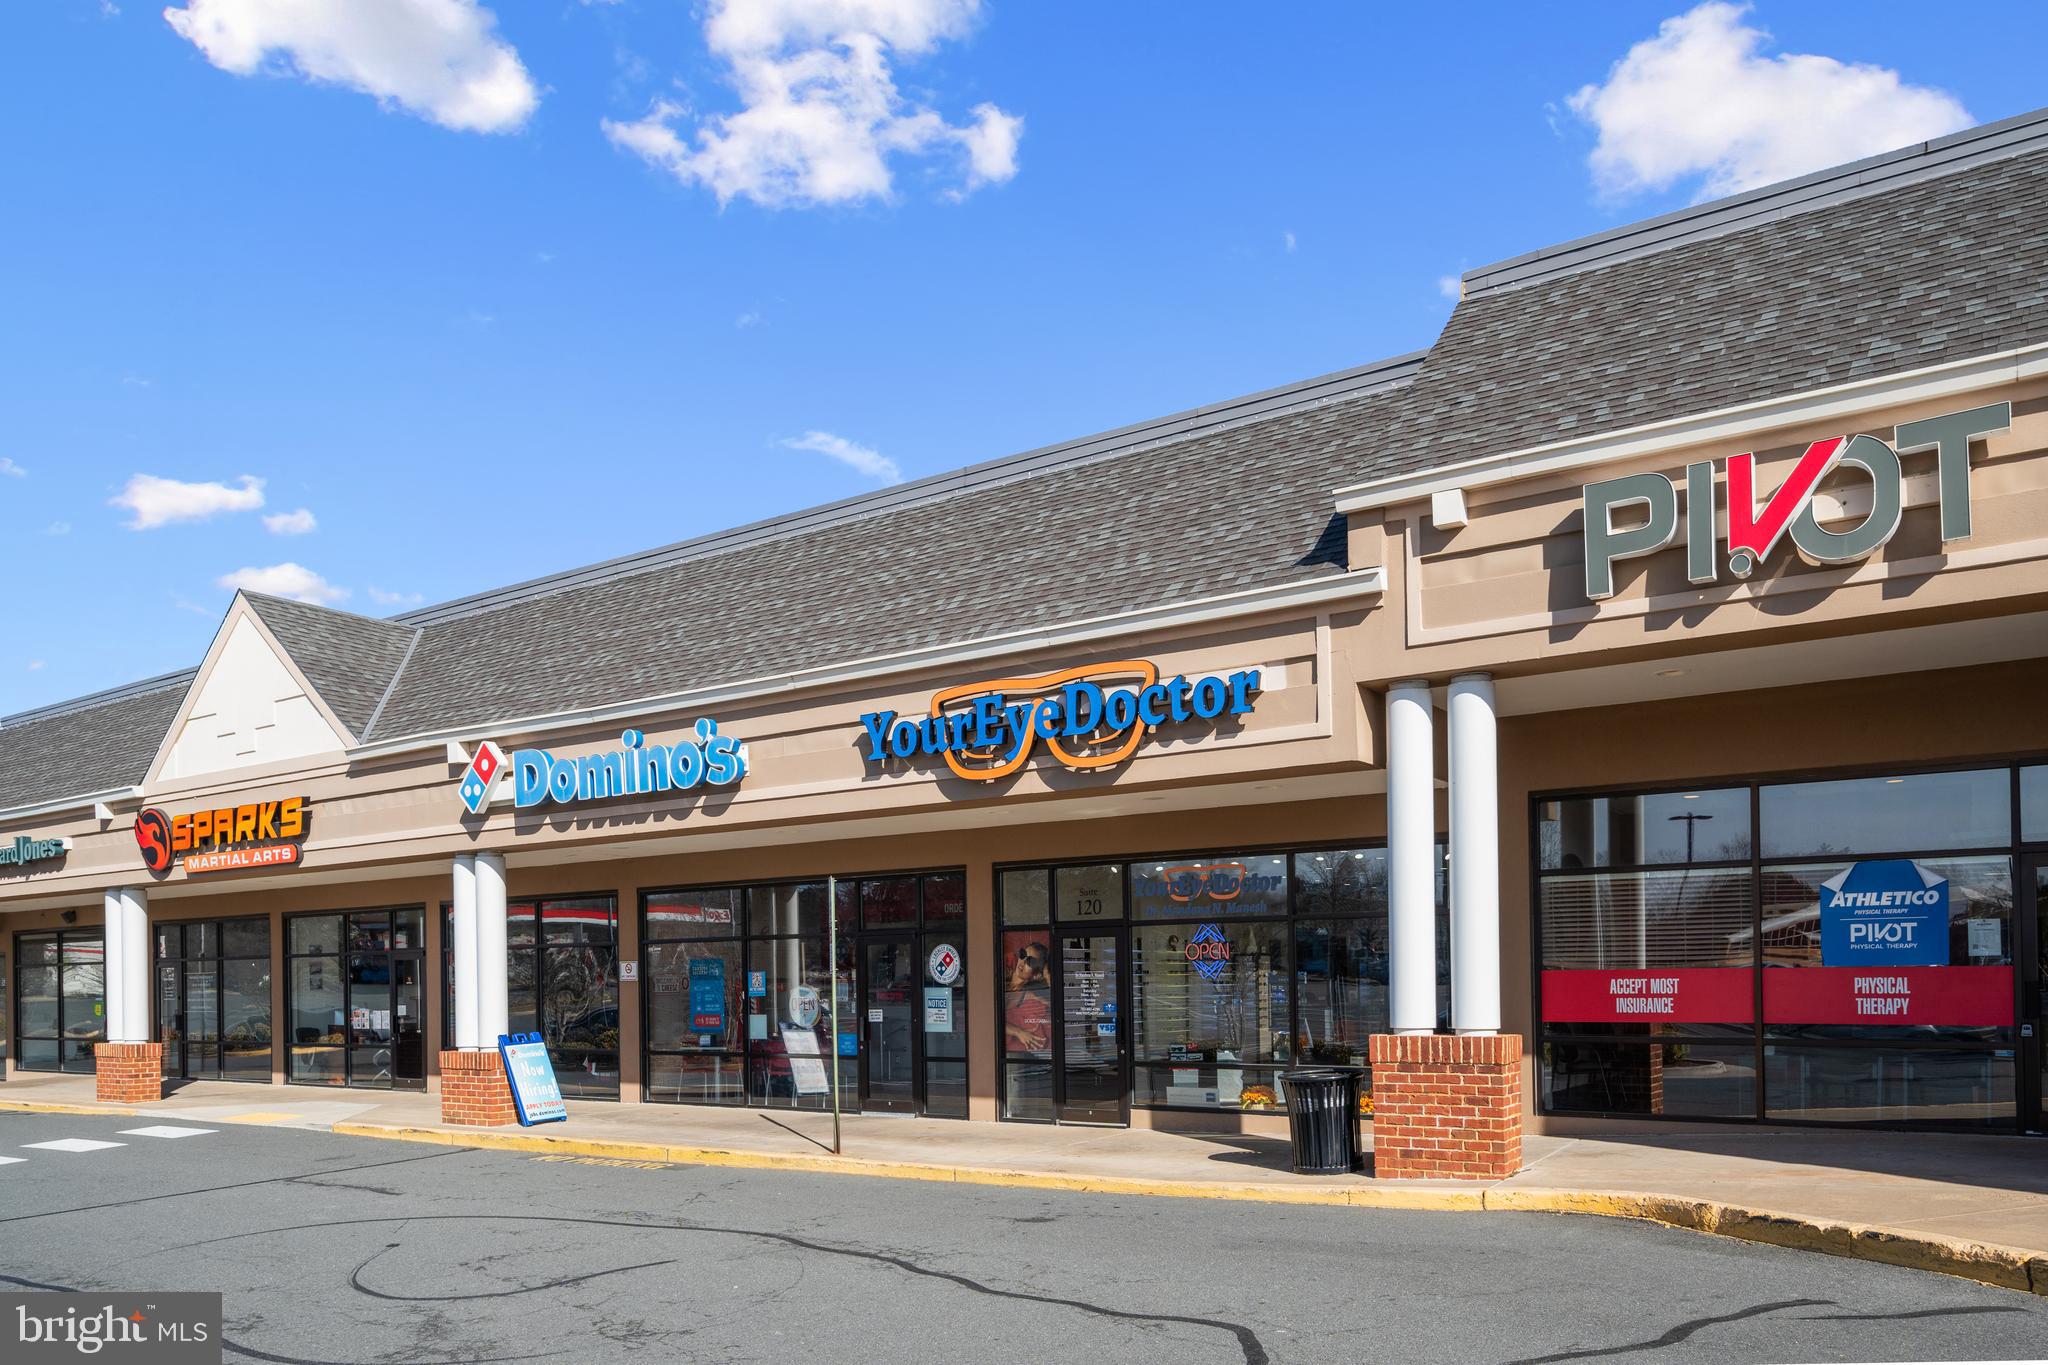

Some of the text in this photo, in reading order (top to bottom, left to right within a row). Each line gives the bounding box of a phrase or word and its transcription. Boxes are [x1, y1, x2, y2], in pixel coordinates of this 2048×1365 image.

[1583, 400, 2012, 600] PIVOT
[860, 669, 1261, 762] YourEyeDoctor
[512, 717, 745, 808] Domino's
[171, 796, 303, 850] SPARKS
[188, 848, 292, 870] MARTIAL ARTS
[1079, 887, 1099, 897] Suite
[1829, 890, 1940, 908] ATHLETICO
[1077, 899, 1102, 916] 120
[1850, 922, 1918, 943] PIVOT
[1185, 942, 1230, 960] OPEN
[1609, 978, 1680, 995] ACCEPT MOST
[1854, 977, 1911, 994] PHYSICAL
[791, 998, 816, 1011] OPEN
[928, 1000, 947, 1008] NOTICE
[1615, 997, 1674, 1014] INSURANCE
[1856, 998, 1909, 1015] THERAPY
[520, 1061, 545, 1076] Now
